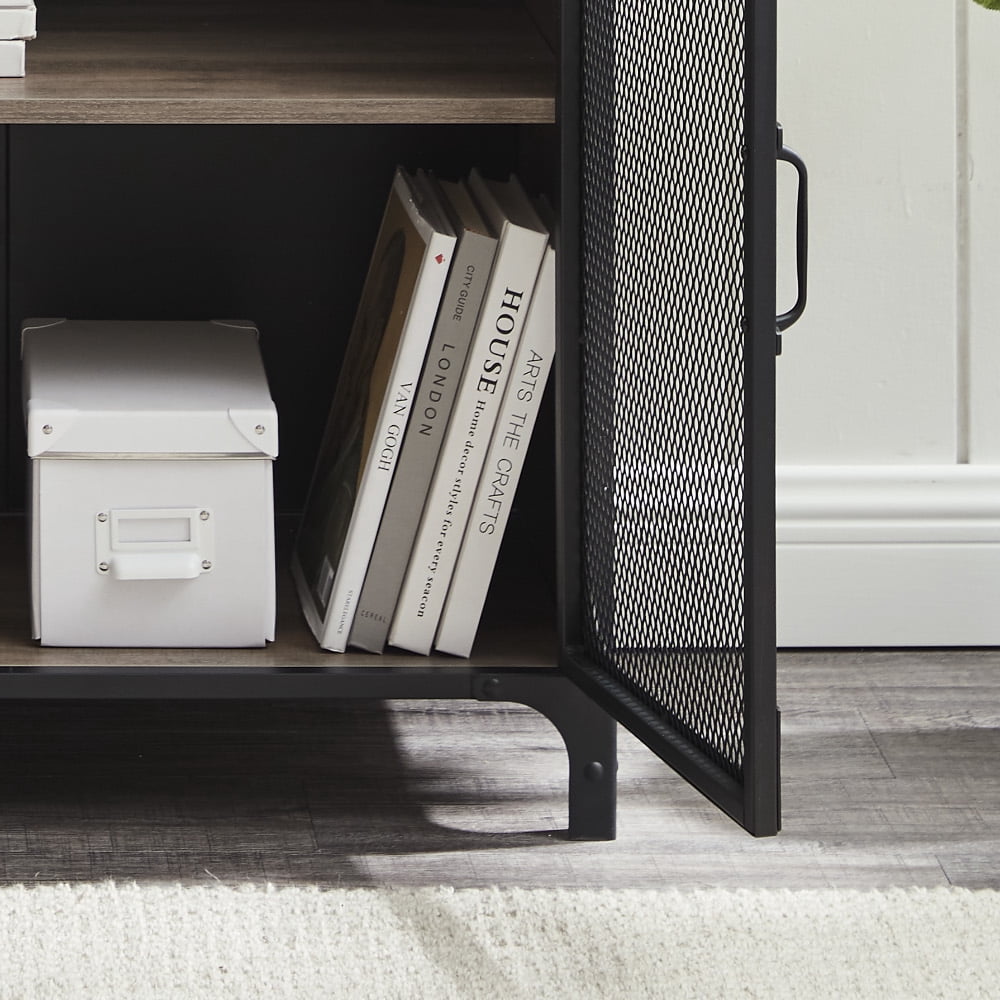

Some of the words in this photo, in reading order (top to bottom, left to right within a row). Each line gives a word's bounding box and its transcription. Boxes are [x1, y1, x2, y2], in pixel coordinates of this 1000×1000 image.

[463, 264, 475, 288] CITY
[452, 290, 468, 322] GUIDE
[477, 286, 524, 395] HOUSE
[419, 343, 456, 436] LONDON
[516, 349, 543, 403] ARTS
[393, 382, 413, 417] VAN
[468, 400, 487, 437] Home
[502, 412, 528, 450] THE
[378, 424, 401, 471] GOGH
[457, 440, 475, 476] decor
[478, 457, 513, 536] CRAFTS
[439, 517, 453, 538] for
[427, 540, 444, 574] every
[417, 577, 434, 618] seacon
